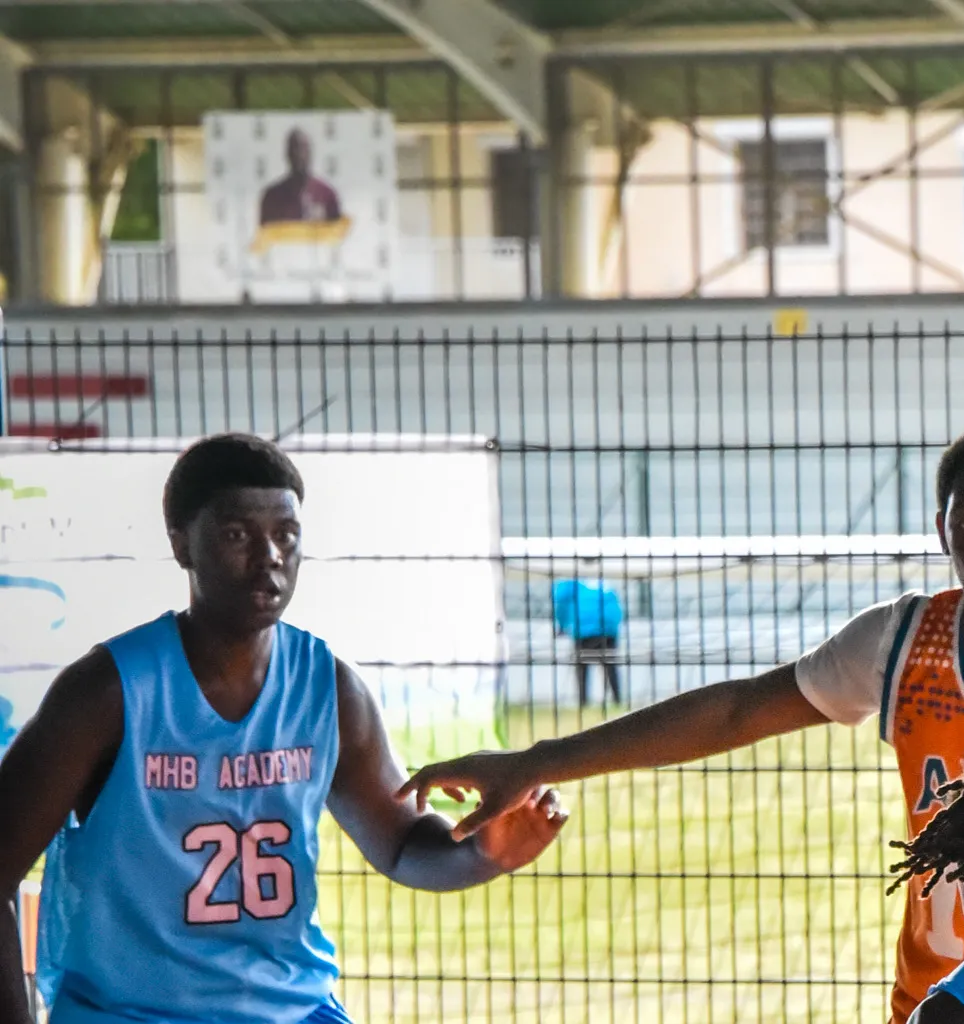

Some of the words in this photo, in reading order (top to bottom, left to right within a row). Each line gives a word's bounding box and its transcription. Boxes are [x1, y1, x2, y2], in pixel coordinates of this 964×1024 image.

[145, 754, 198, 790] MHB
[218, 746, 313, 790] ACADEMY
[182, 820, 297, 925] 26
